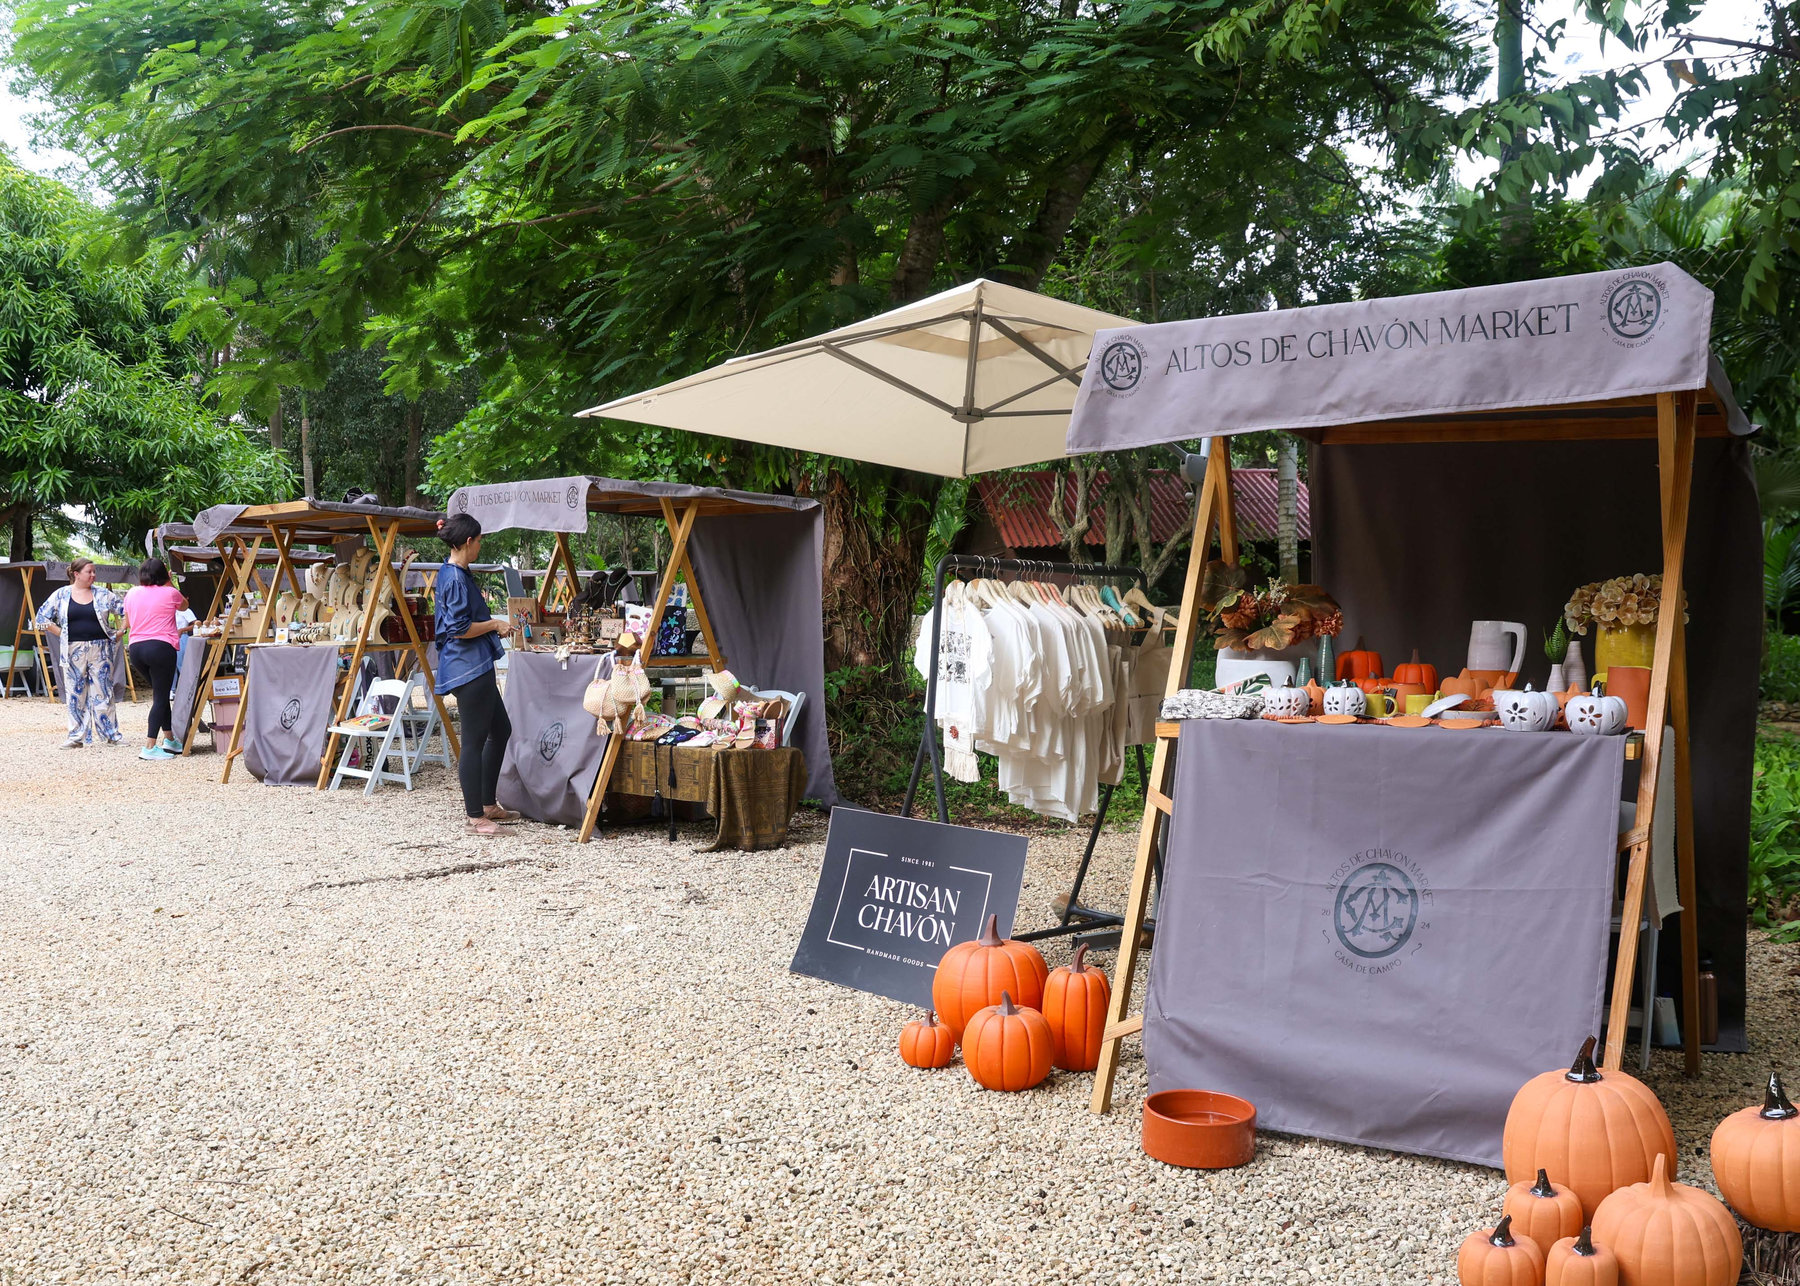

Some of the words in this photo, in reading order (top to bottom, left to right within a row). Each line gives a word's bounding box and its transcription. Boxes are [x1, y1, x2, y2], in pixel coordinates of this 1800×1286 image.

[1164, 340, 1252, 376] ALTOS
[1260, 334, 1297, 364] DE
[1307, 318, 1429, 358] CHAVÓN
[1440, 302, 1579, 345] MARKET
[532, 491, 561, 504] MARKET
[901, 856, 920, 866] SINCE
[921, 859, 935, 868] 1981
[1325, 863, 1351, 893] ALTOS
[1349, 851, 1365, 867] DE
[1408, 862, 1434, 907] MARKET
[863, 874, 961, 916] ARTISAN
[1321, 908, 1331, 917] 20
[858, 903, 955, 947] CHAVÓN
[1420, 921, 1431, 930] 24
[866, 948, 901, 962] HANDMADE
[902, 957, 924, 968] GOODS
[1334, 949, 1353, 969] CASA
[1355, 963, 1367, 974] DE
[1369, 958, 1402, 975] CAMPO
